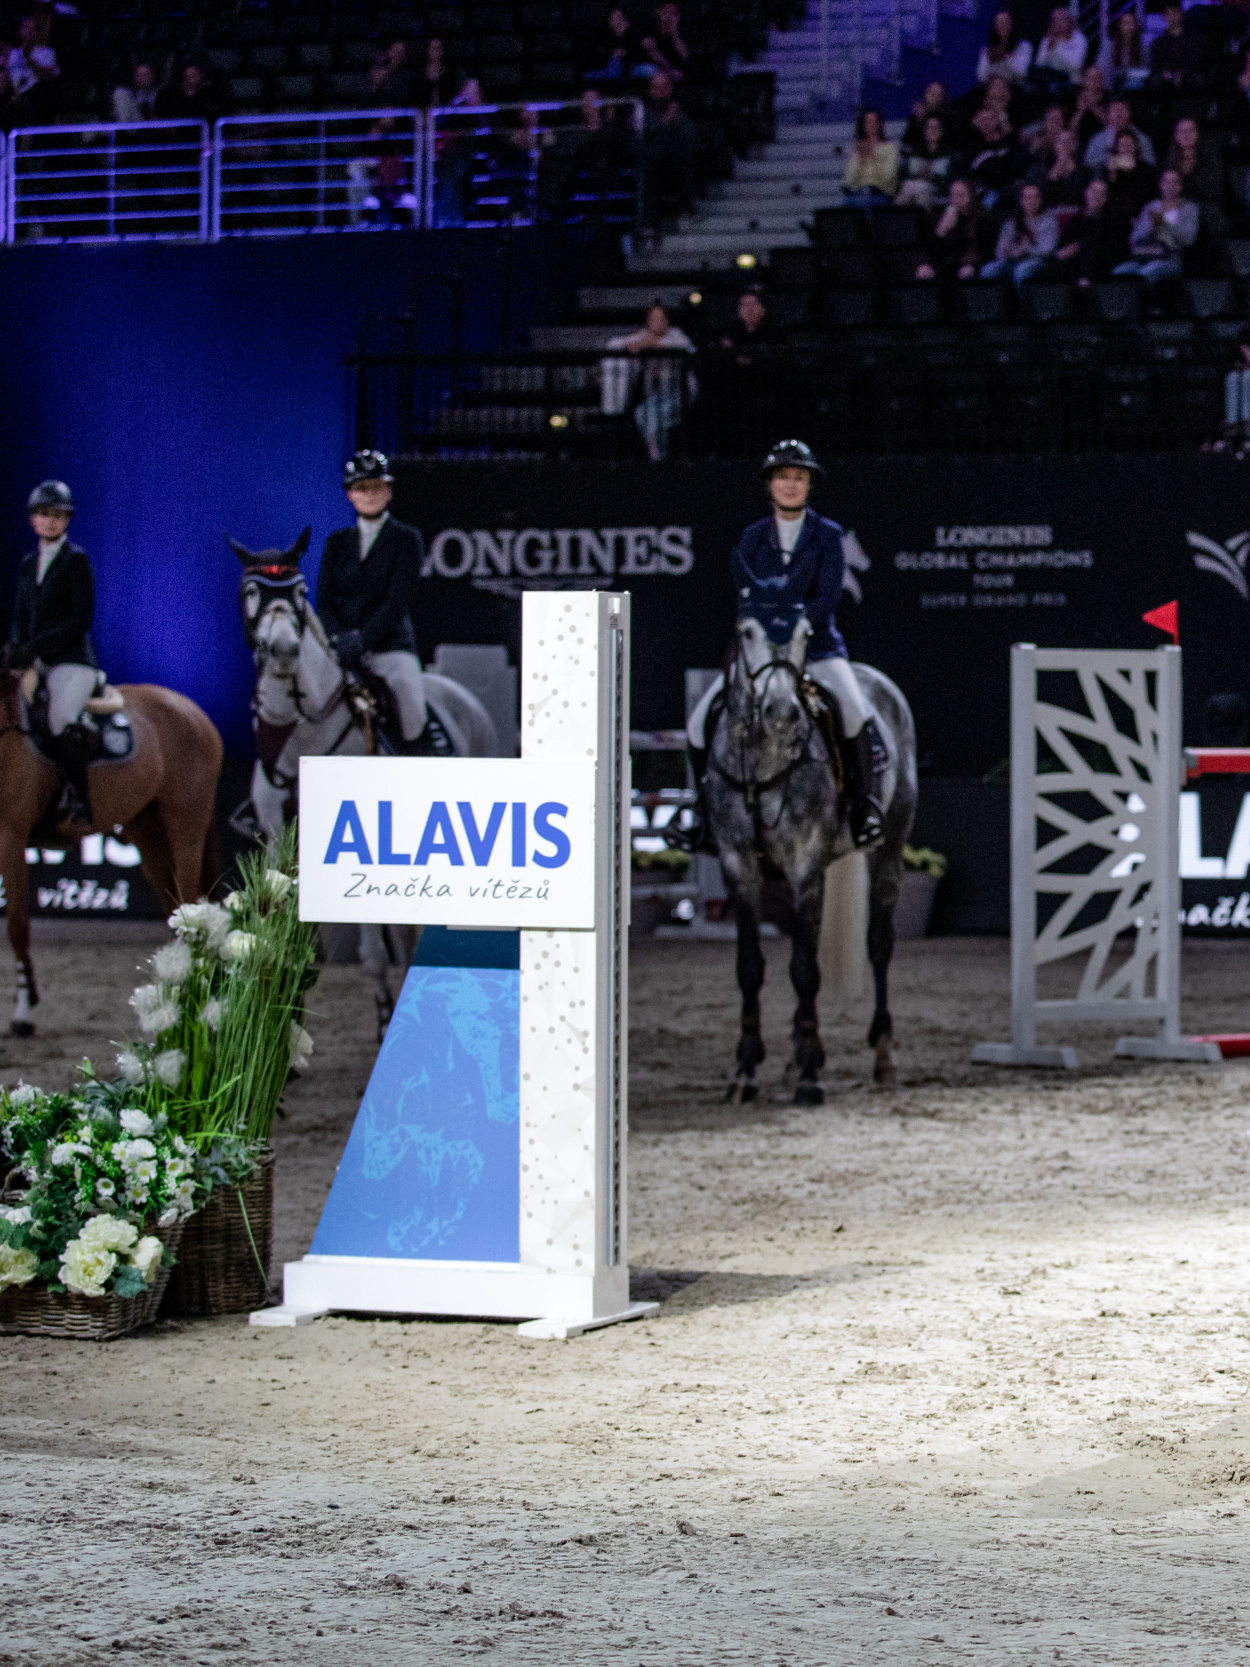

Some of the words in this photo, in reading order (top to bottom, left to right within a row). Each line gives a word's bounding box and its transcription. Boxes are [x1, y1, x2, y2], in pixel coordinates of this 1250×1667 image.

[419, 526, 694, 578] ONGINES
[323, 800, 571, 869] ALAVIS
[343, 873, 453, 898] Značka
[469, 878, 549, 900] vítězů
